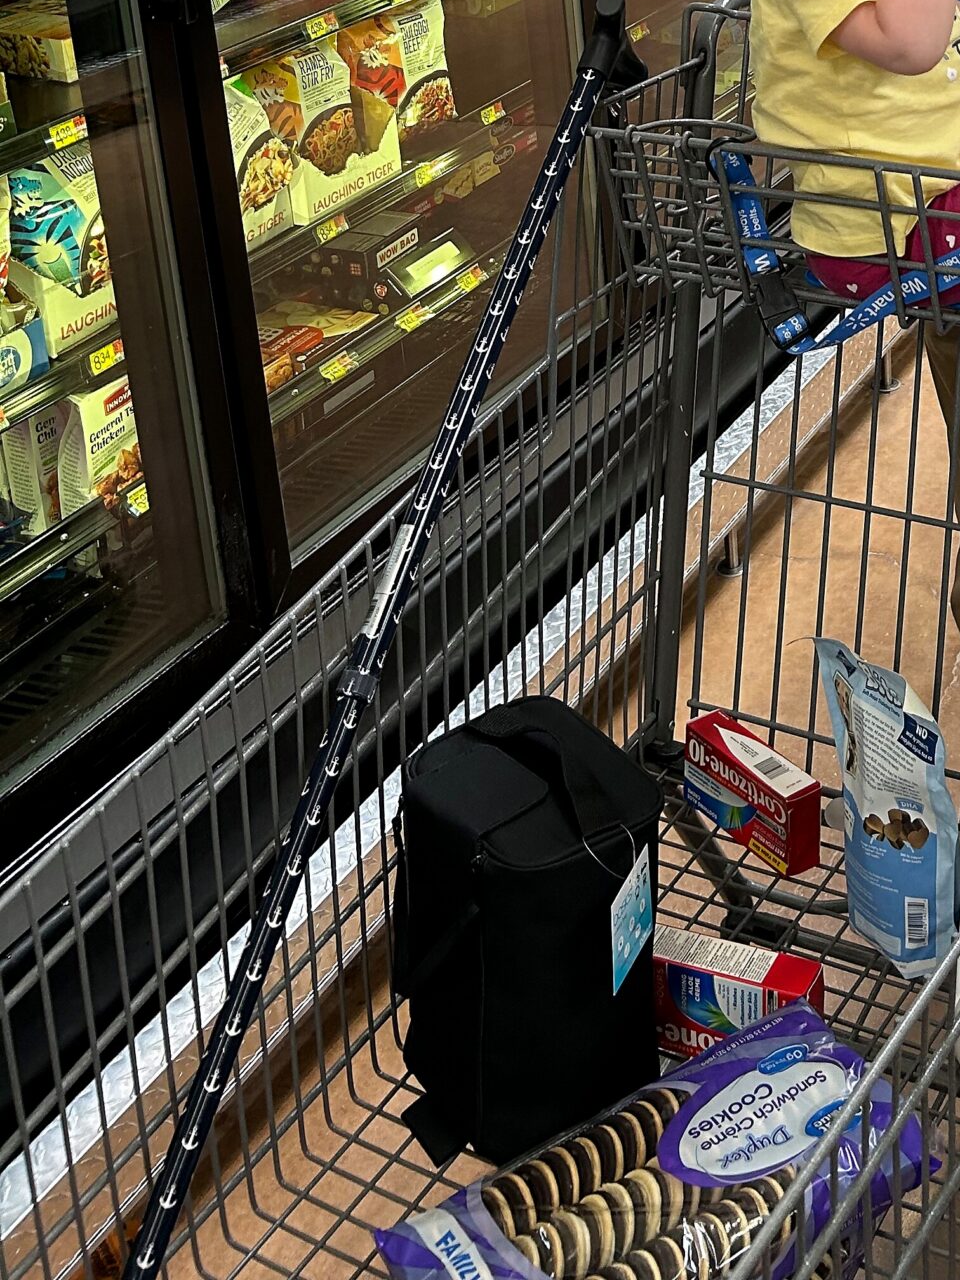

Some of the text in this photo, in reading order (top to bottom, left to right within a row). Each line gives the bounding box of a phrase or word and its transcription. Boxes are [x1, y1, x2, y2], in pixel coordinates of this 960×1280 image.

[403, 37, 421, 56] BEEF
[297, 52, 329, 75] RAMEN
[301, 63, 335, 91] STIR FRY
[54, 125, 73, 145] 438
[313, 162, 395, 215] LAUGHING TIGER
[257, 211, 286, 235] TIGER
[378, 232, 417, 264] WOW BAO
[864, 276, 927, 318] Wamart
[61, 301, 118, 341] LAUGHIN
[93, 349, 111, 371] 834
[106, 388, 131, 412] INNOVA
[89, 414, 124, 444] General
[90, 424, 126, 455] Chicken
[916, 723, 928, 740] NO
[900, 801, 919, 811] DHA
[771, 1016, 784, 1027] NET
[687, 1083, 773, 1140] Cookies
[700, 1069, 828, 1152] Sandwich Crème
[716, 1125, 794, 1170] Duplex
